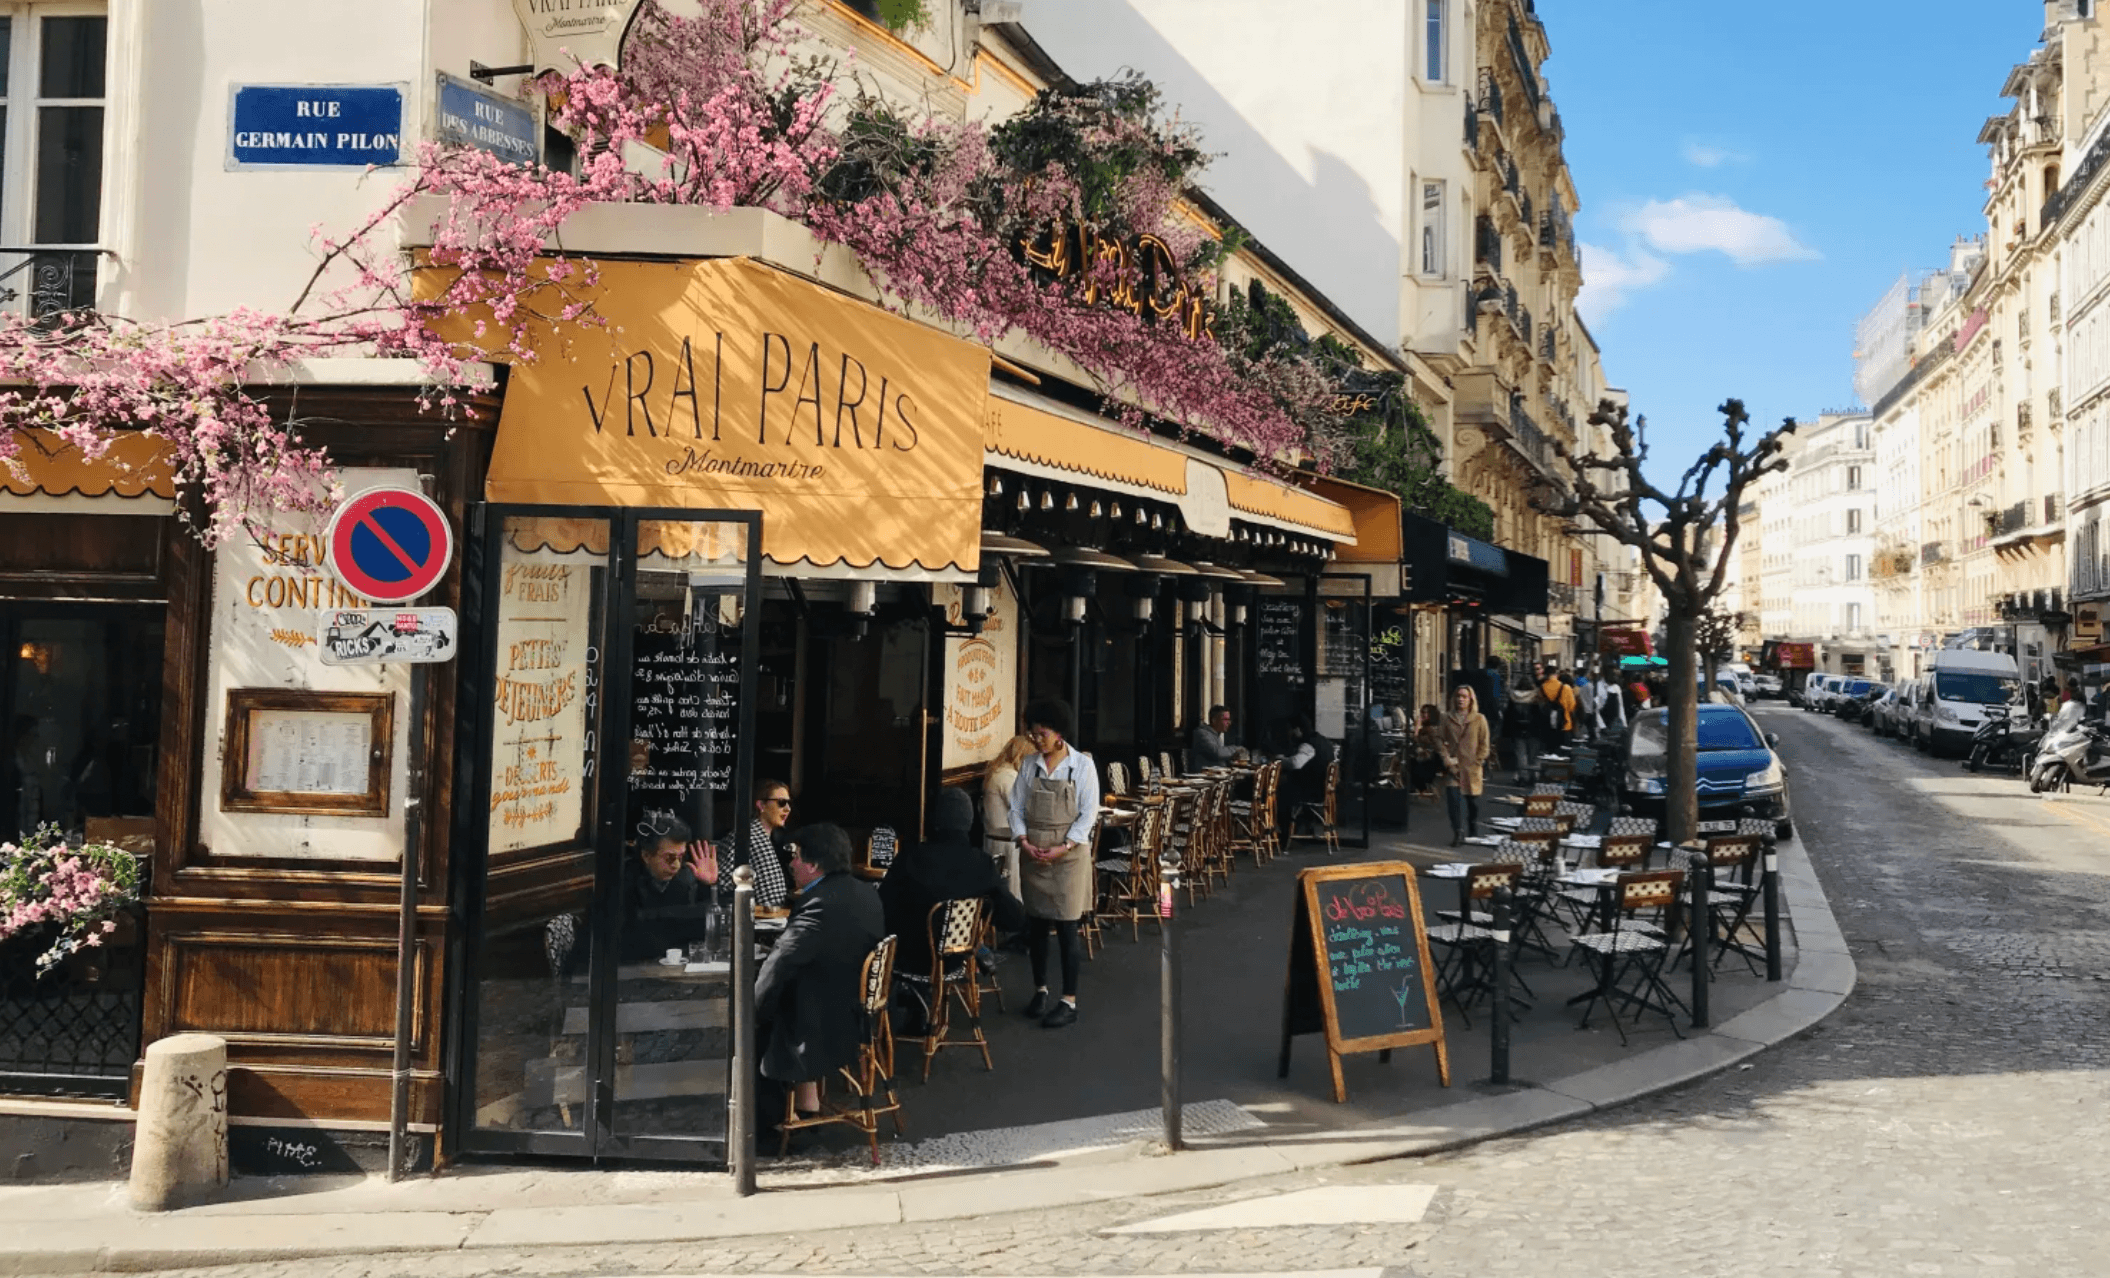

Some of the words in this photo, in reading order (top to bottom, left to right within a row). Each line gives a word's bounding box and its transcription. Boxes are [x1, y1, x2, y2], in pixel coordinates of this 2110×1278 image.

[545, 15, 606, 32] Montmartre
[296, 101, 341, 118] RUE
[475, 100, 504, 125] RUE
[236, 132, 328, 149] GERMAIN
[336, 131, 399, 149] PILON
[442, 112, 468, 134] DES
[471, 124, 534, 157] ABBESSES
[582, 332, 723, 440] VRAI
[759, 332, 919, 452] PARIS
[665, 445, 827, 480] Montmartre
[262, 533, 327, 567] SERV
[246, 576, 368, 609] CONTIN
[518, 582, 560, 602] FRAIS
[335, 637, 370, 658] RICKS
[509, 639, 561, 670] PETITS
